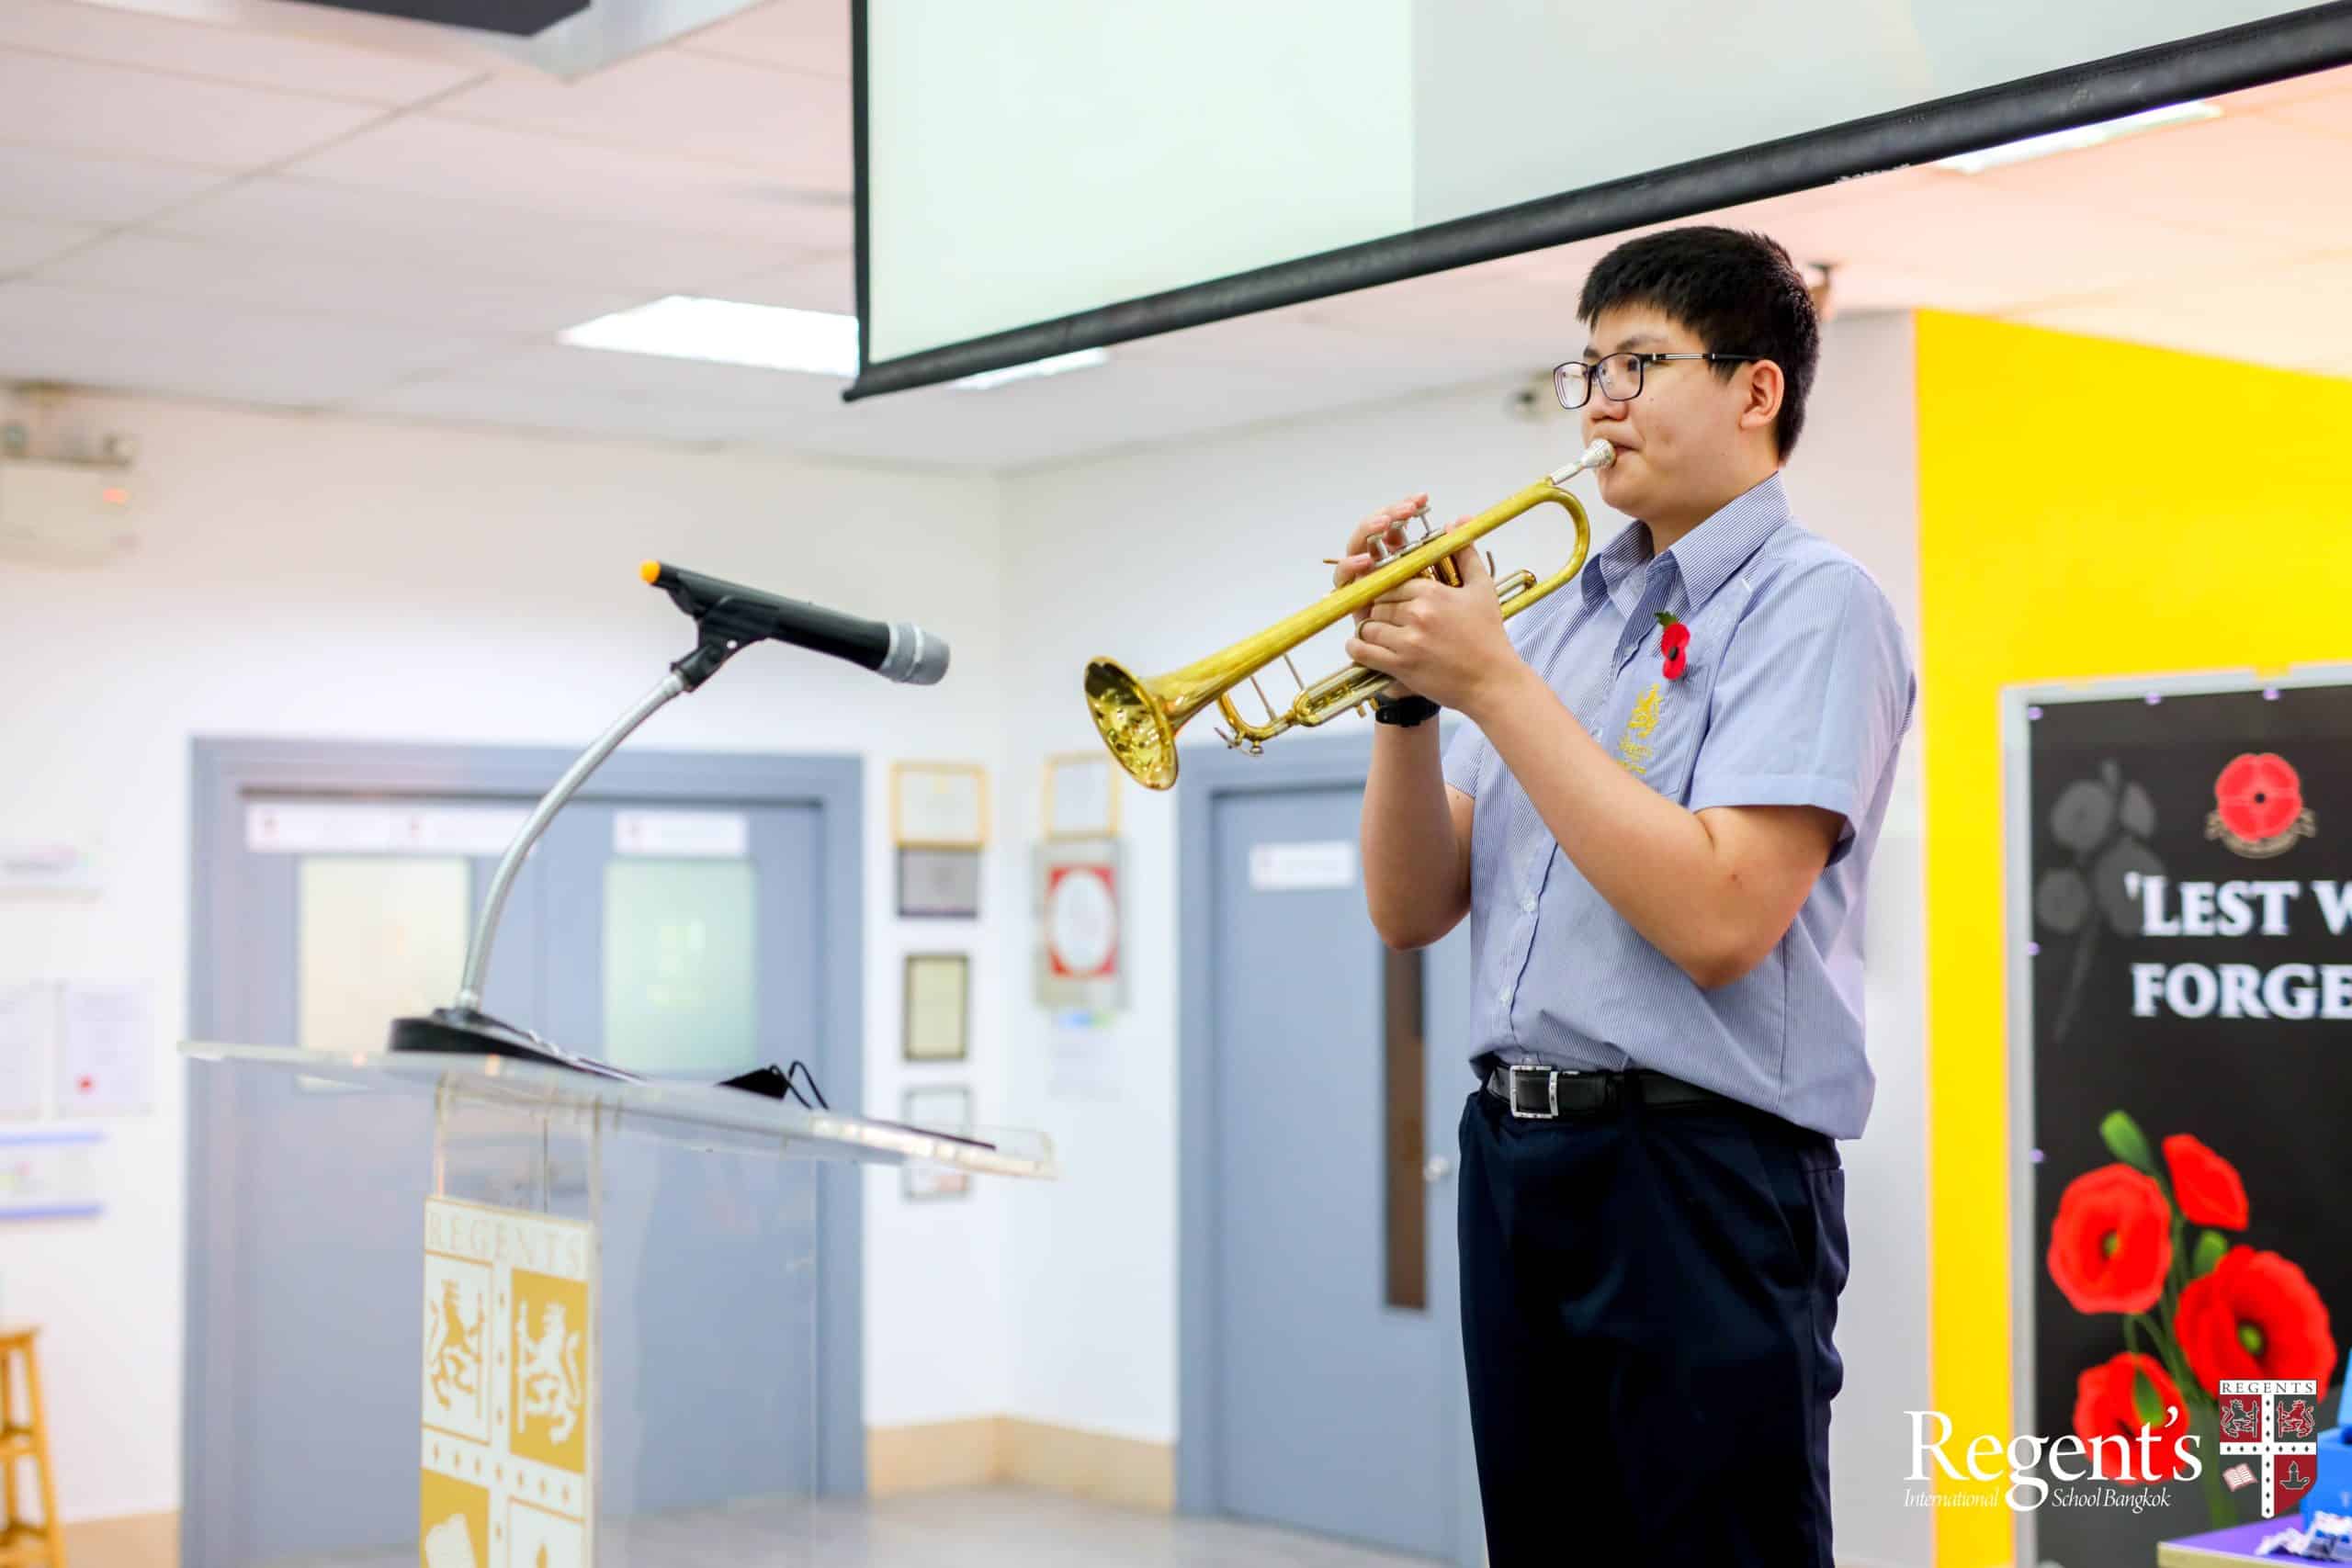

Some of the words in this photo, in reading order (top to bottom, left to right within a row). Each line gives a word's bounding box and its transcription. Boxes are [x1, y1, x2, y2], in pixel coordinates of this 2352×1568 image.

[2124, 871, 2300, 936] 'LEST
[2131, 962, 2352, 1020] FORGE
[426, 1210, 582, 1275] REGENTS
